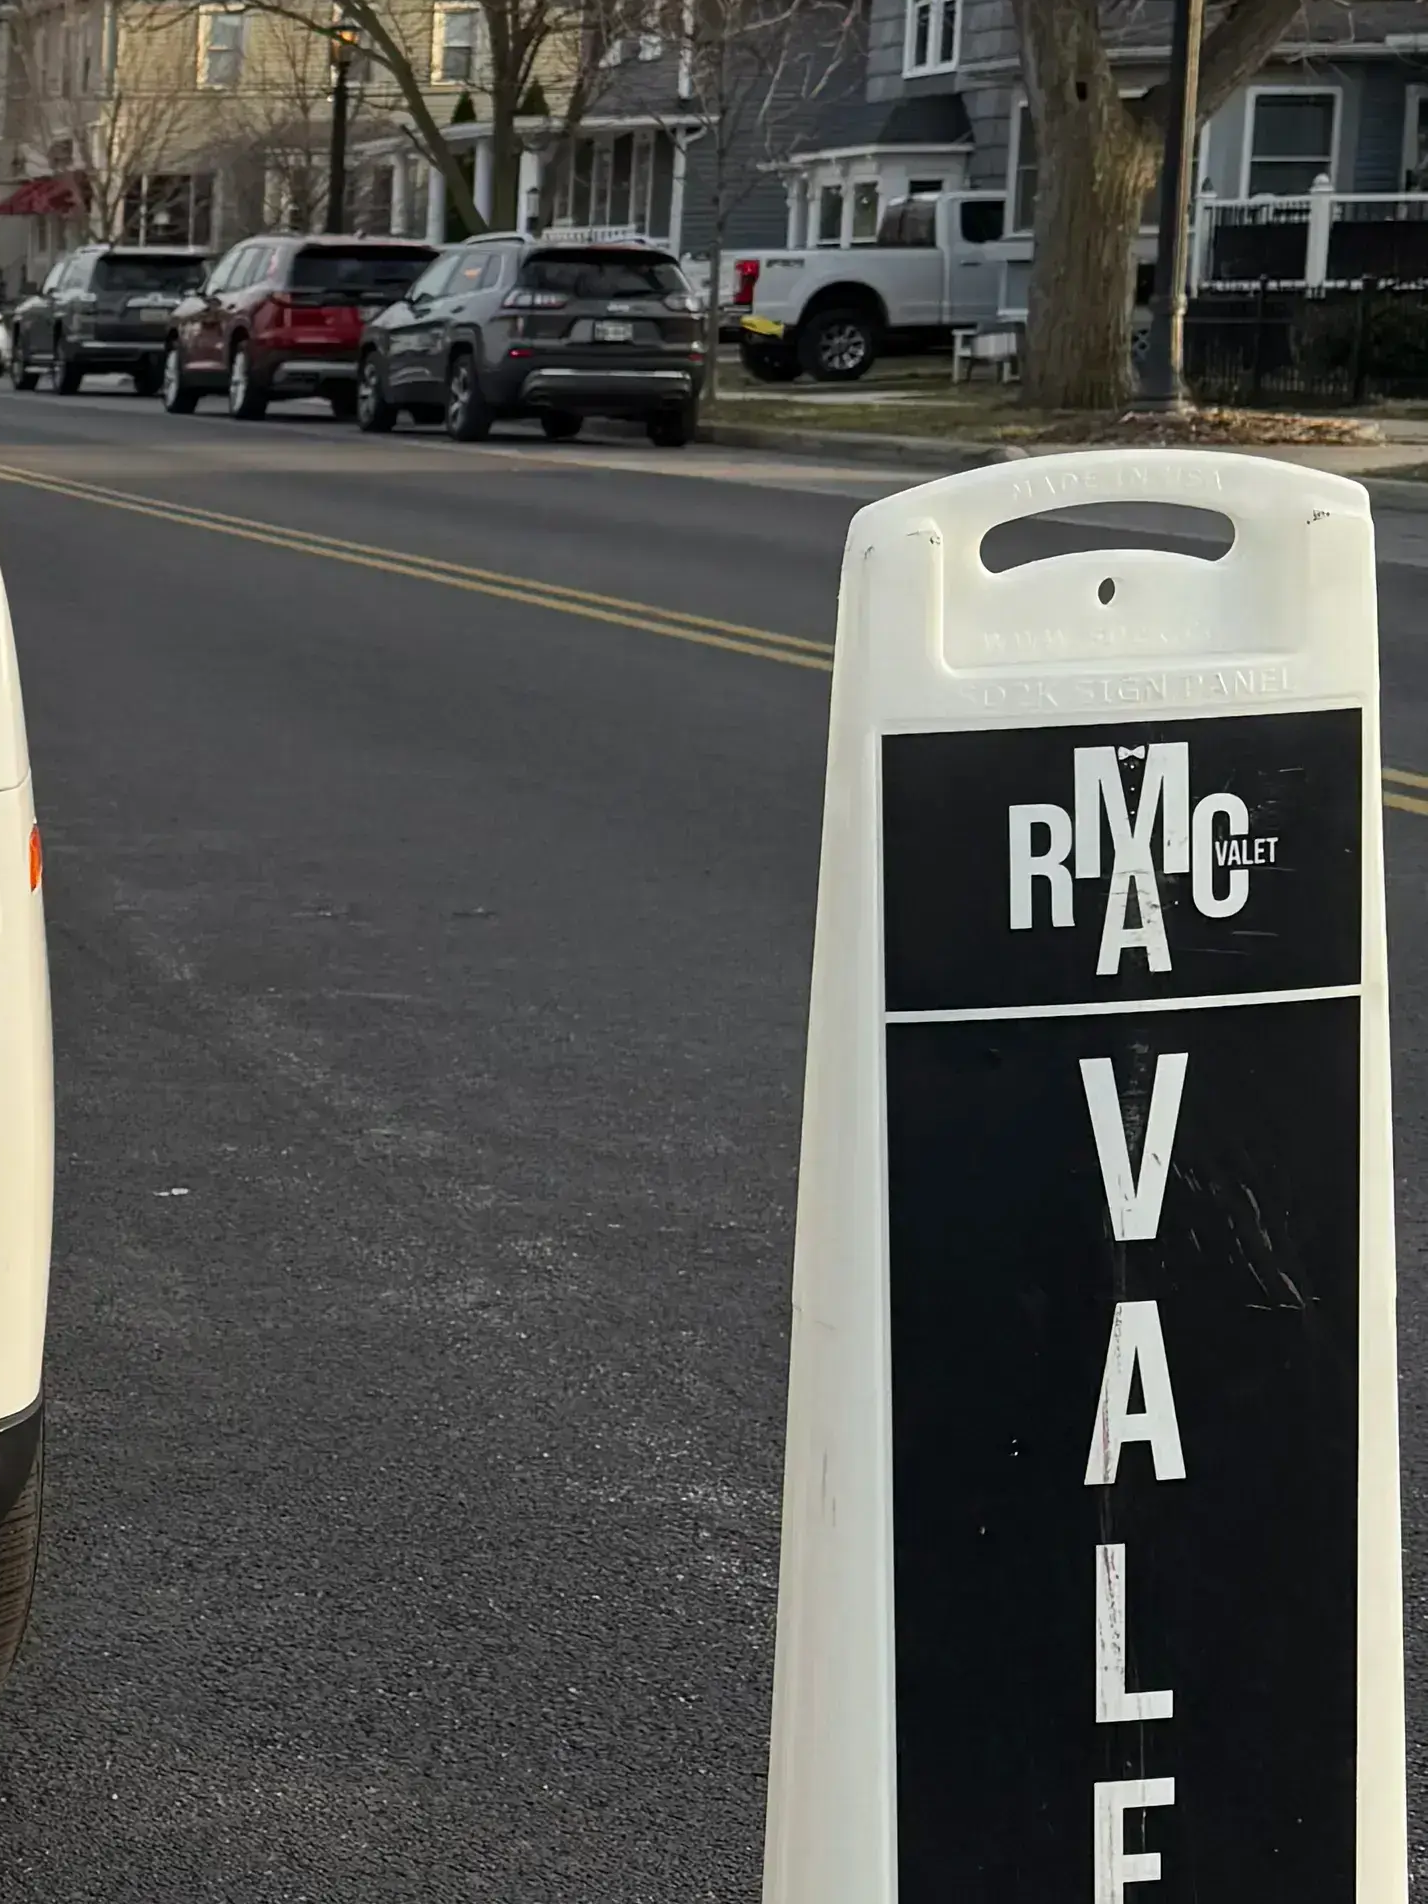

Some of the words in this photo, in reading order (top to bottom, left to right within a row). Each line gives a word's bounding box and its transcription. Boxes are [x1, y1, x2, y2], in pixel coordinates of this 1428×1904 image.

[1080, 674, 1168, 704] SIGN
[1185, 667, 1298, 699] PANEL
[1215, 837, 1279, 867] VALET
